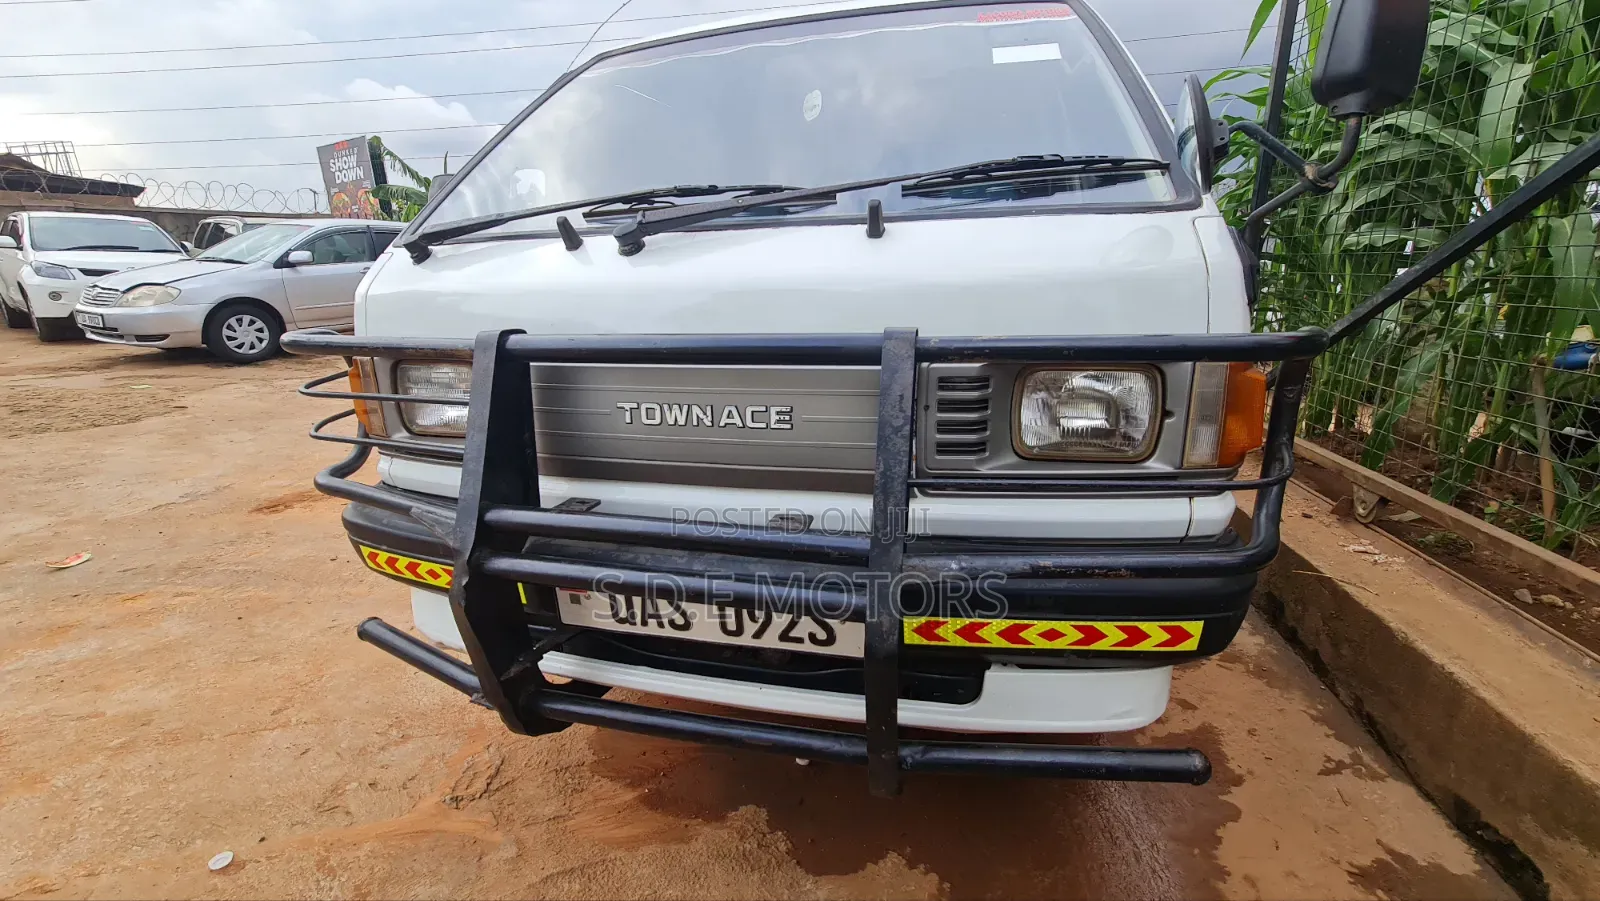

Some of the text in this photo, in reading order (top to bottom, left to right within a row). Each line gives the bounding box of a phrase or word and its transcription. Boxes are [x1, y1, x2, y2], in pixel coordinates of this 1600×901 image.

[333, 147, 358, 159] DUNKED
[329, 154, 358, 173] SHOW
[334, 166, 364, 184] DOWN
